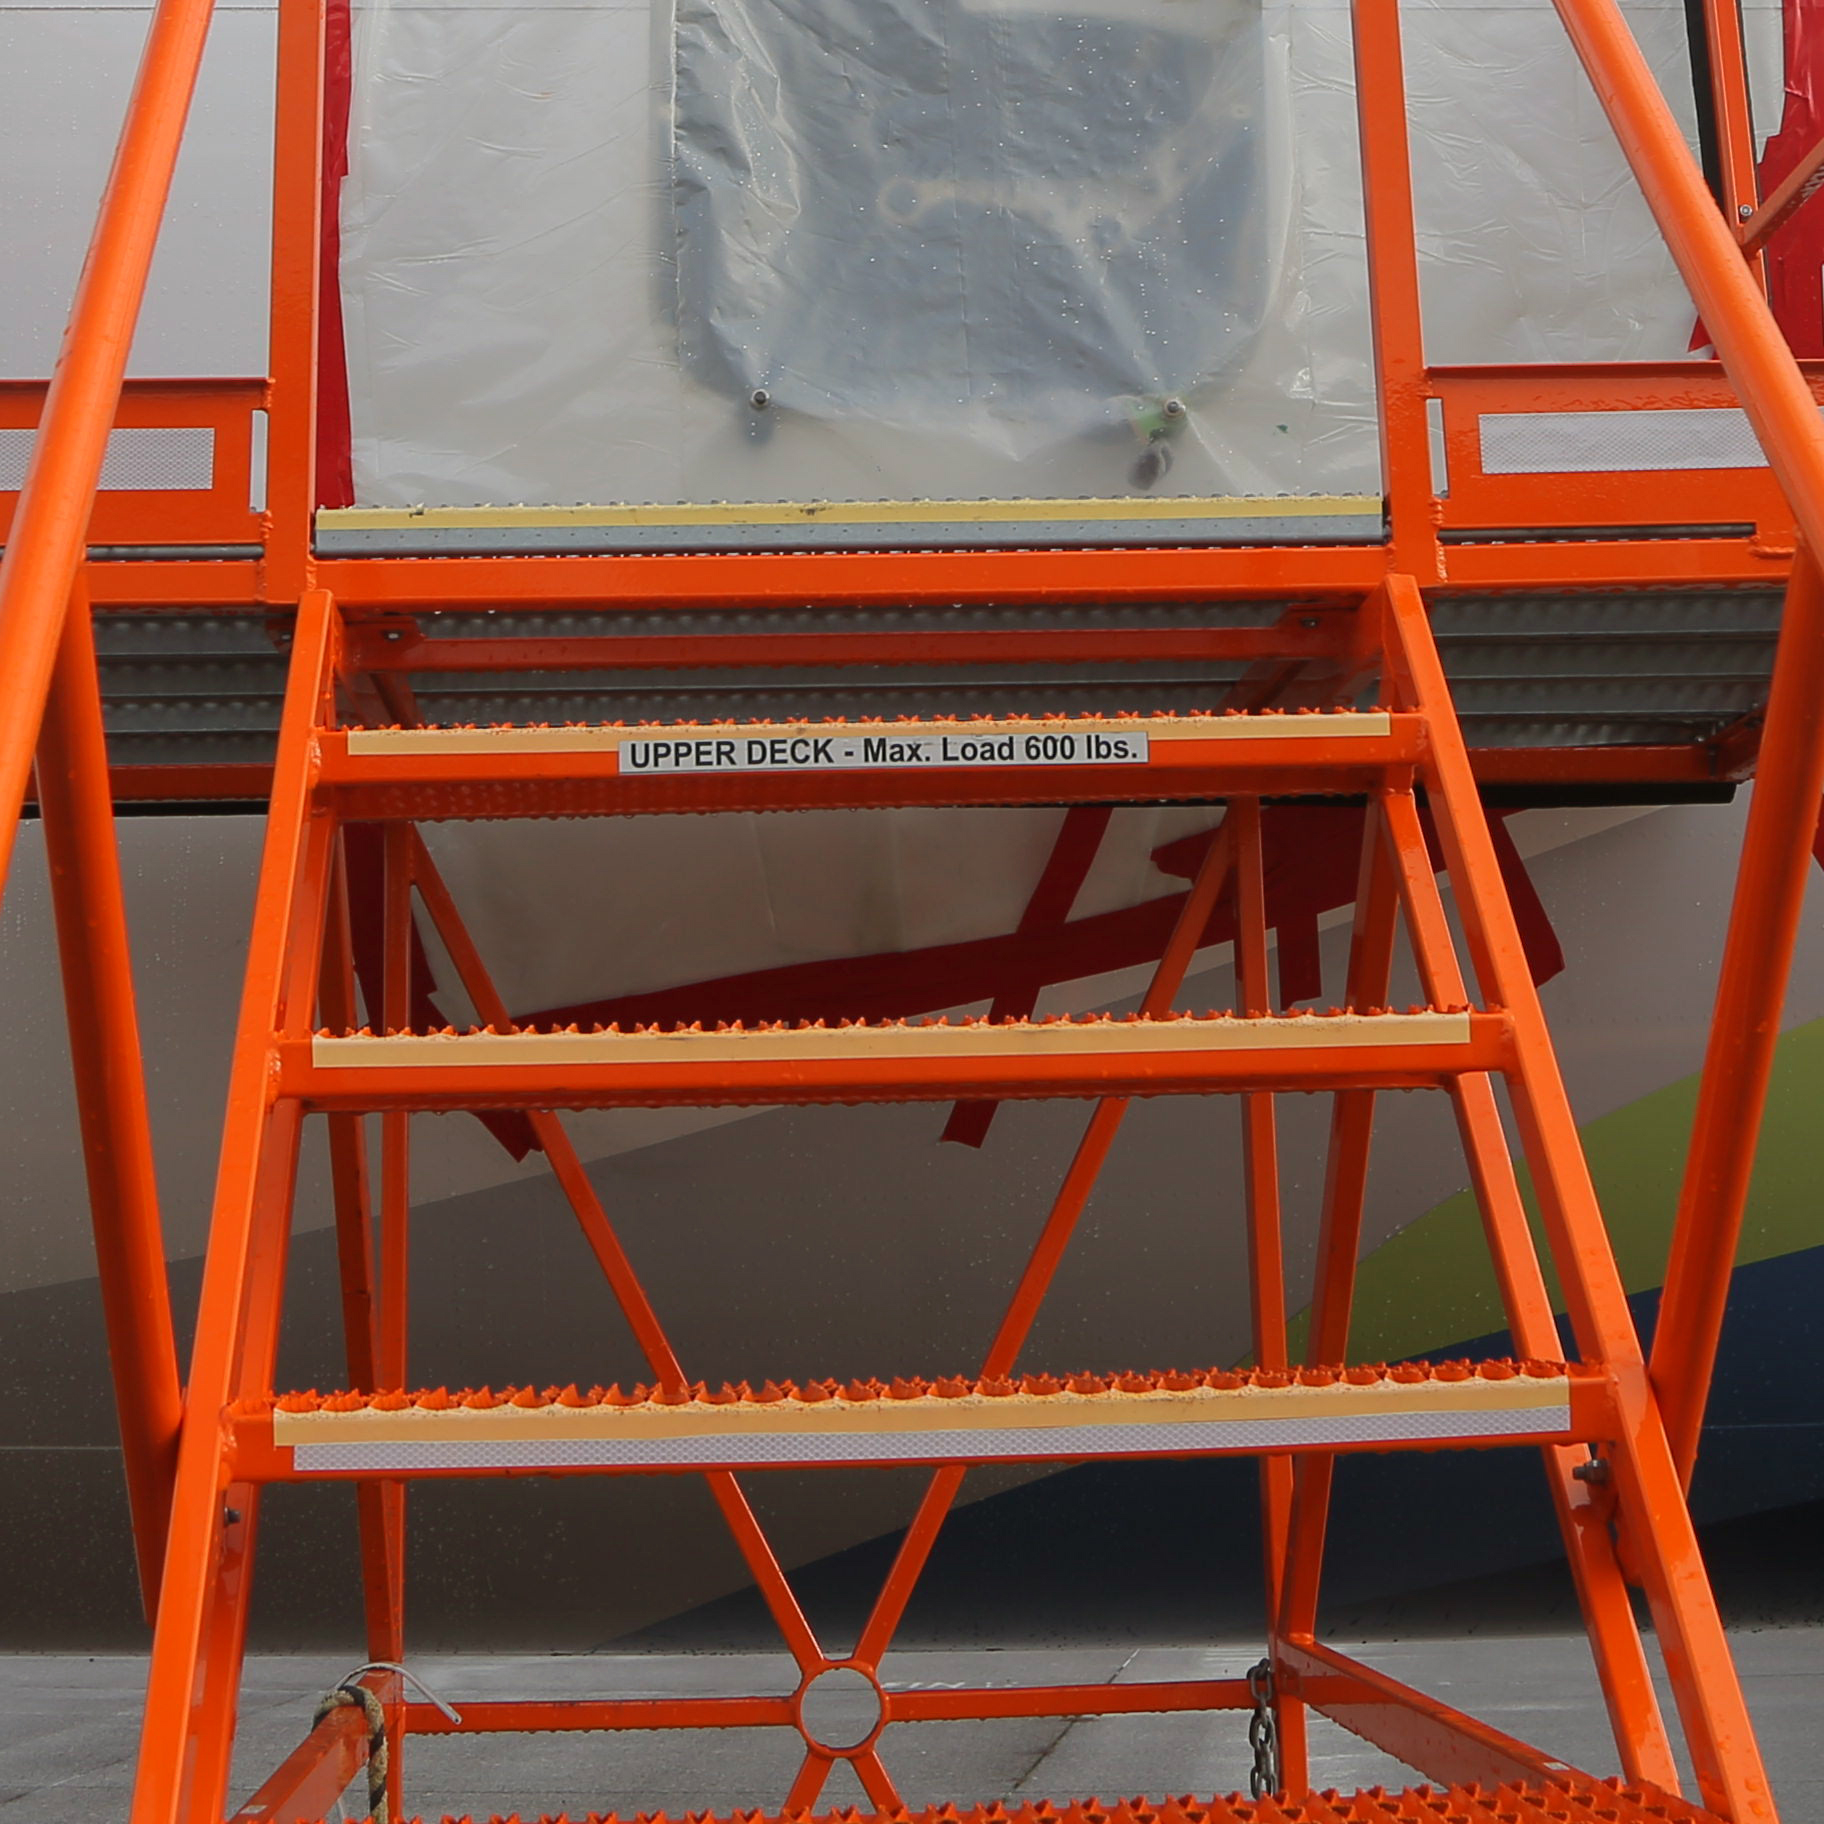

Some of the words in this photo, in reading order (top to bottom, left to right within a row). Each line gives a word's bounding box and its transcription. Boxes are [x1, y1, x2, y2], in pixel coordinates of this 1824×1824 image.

[629, 740, 737, 769] UPPER
[746, 738, 835, 765] DECK
[863, 737, 932, 763] Max.
[942, 735, 1015, 762] Load
[1024, 734, 1077, 761] 600
[1086, 734, 1139, 760] lbs.
